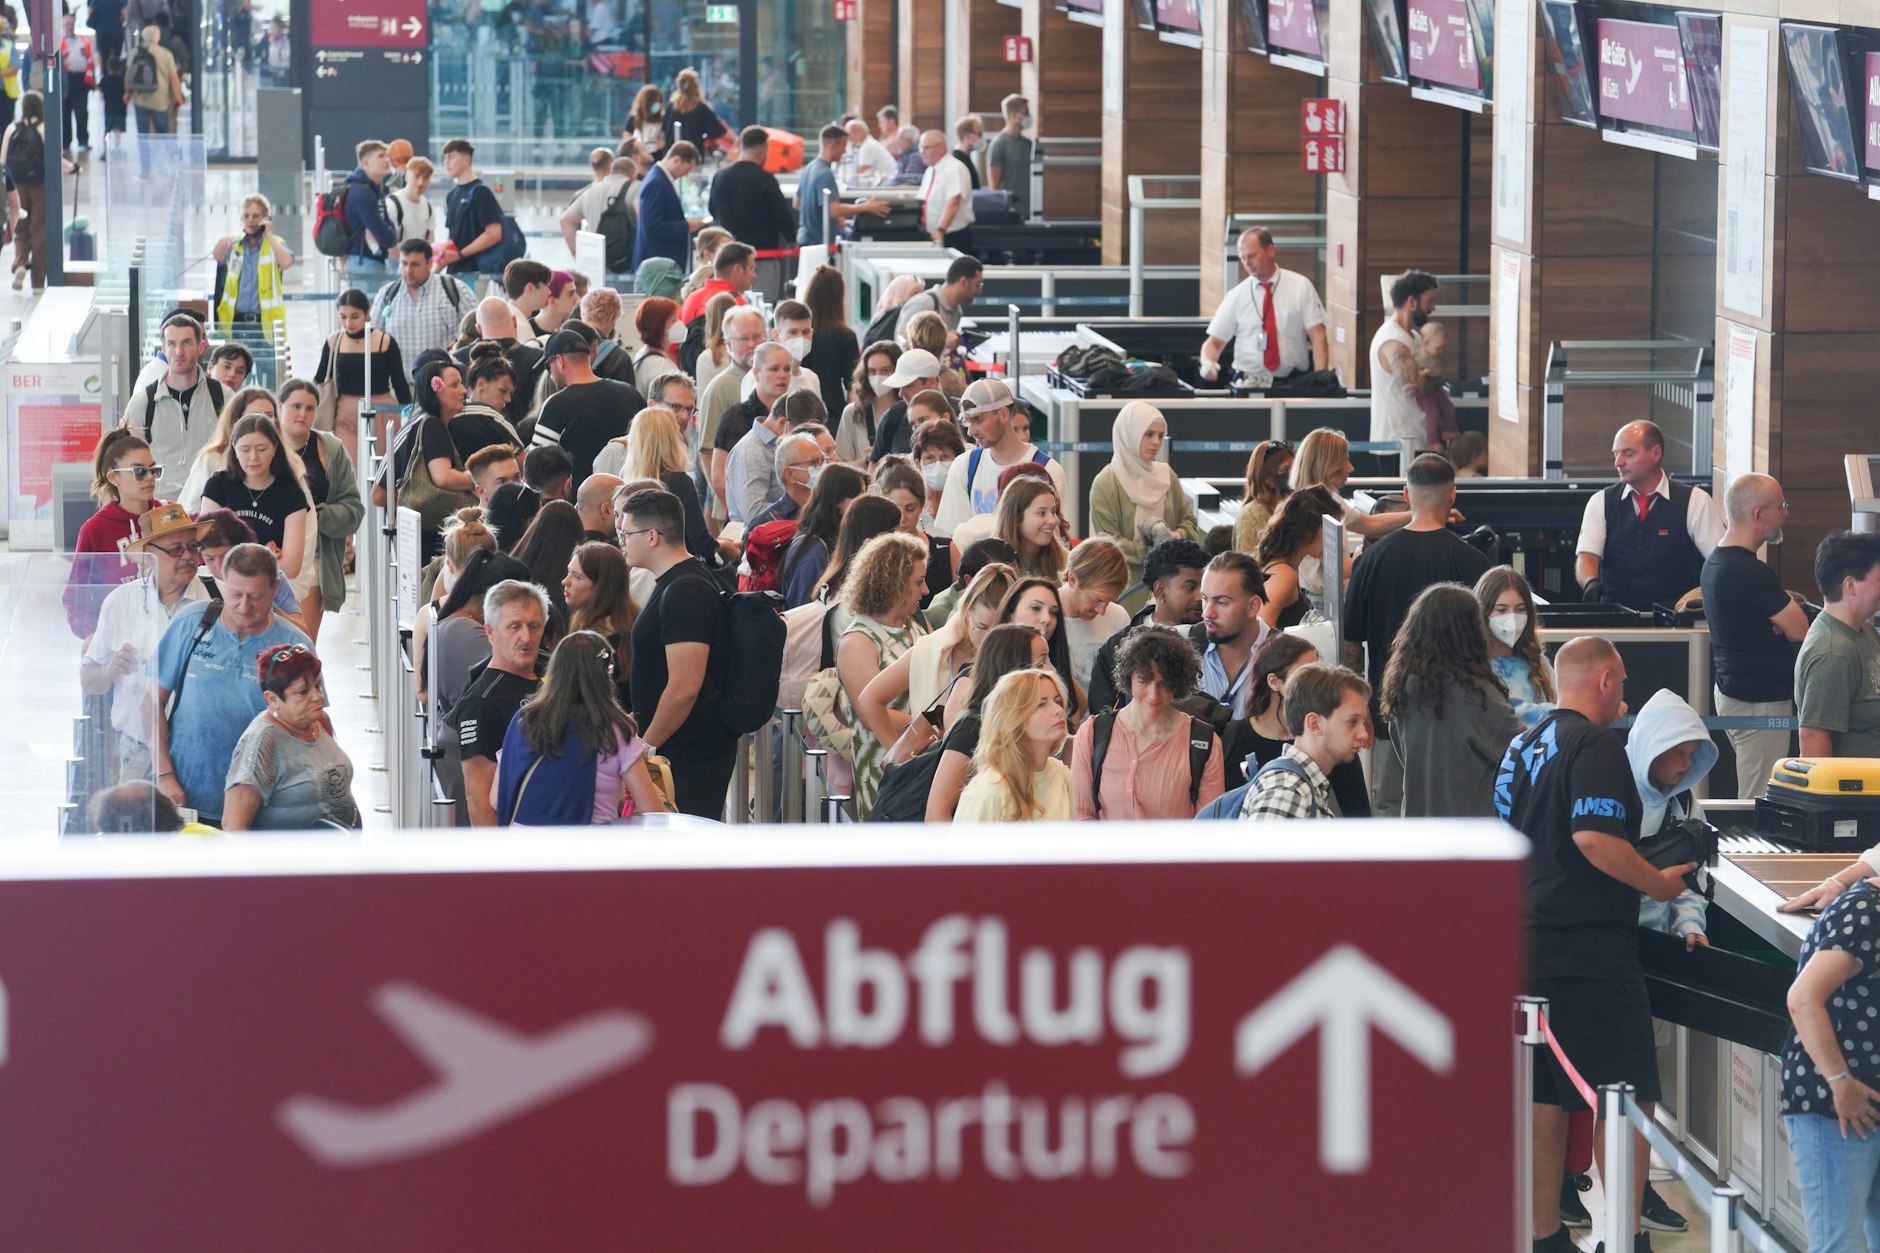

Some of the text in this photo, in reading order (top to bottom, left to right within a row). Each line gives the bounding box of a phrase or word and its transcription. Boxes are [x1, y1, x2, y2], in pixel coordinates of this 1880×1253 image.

[1611, 40, 1626, 67] Gates
[1869, 75, 1880, 106] All
[13, 375, 41, 387] BER
[720, 913, 1191, 1077] Abflug
[668, 1081, 1195, 1208] Departure
